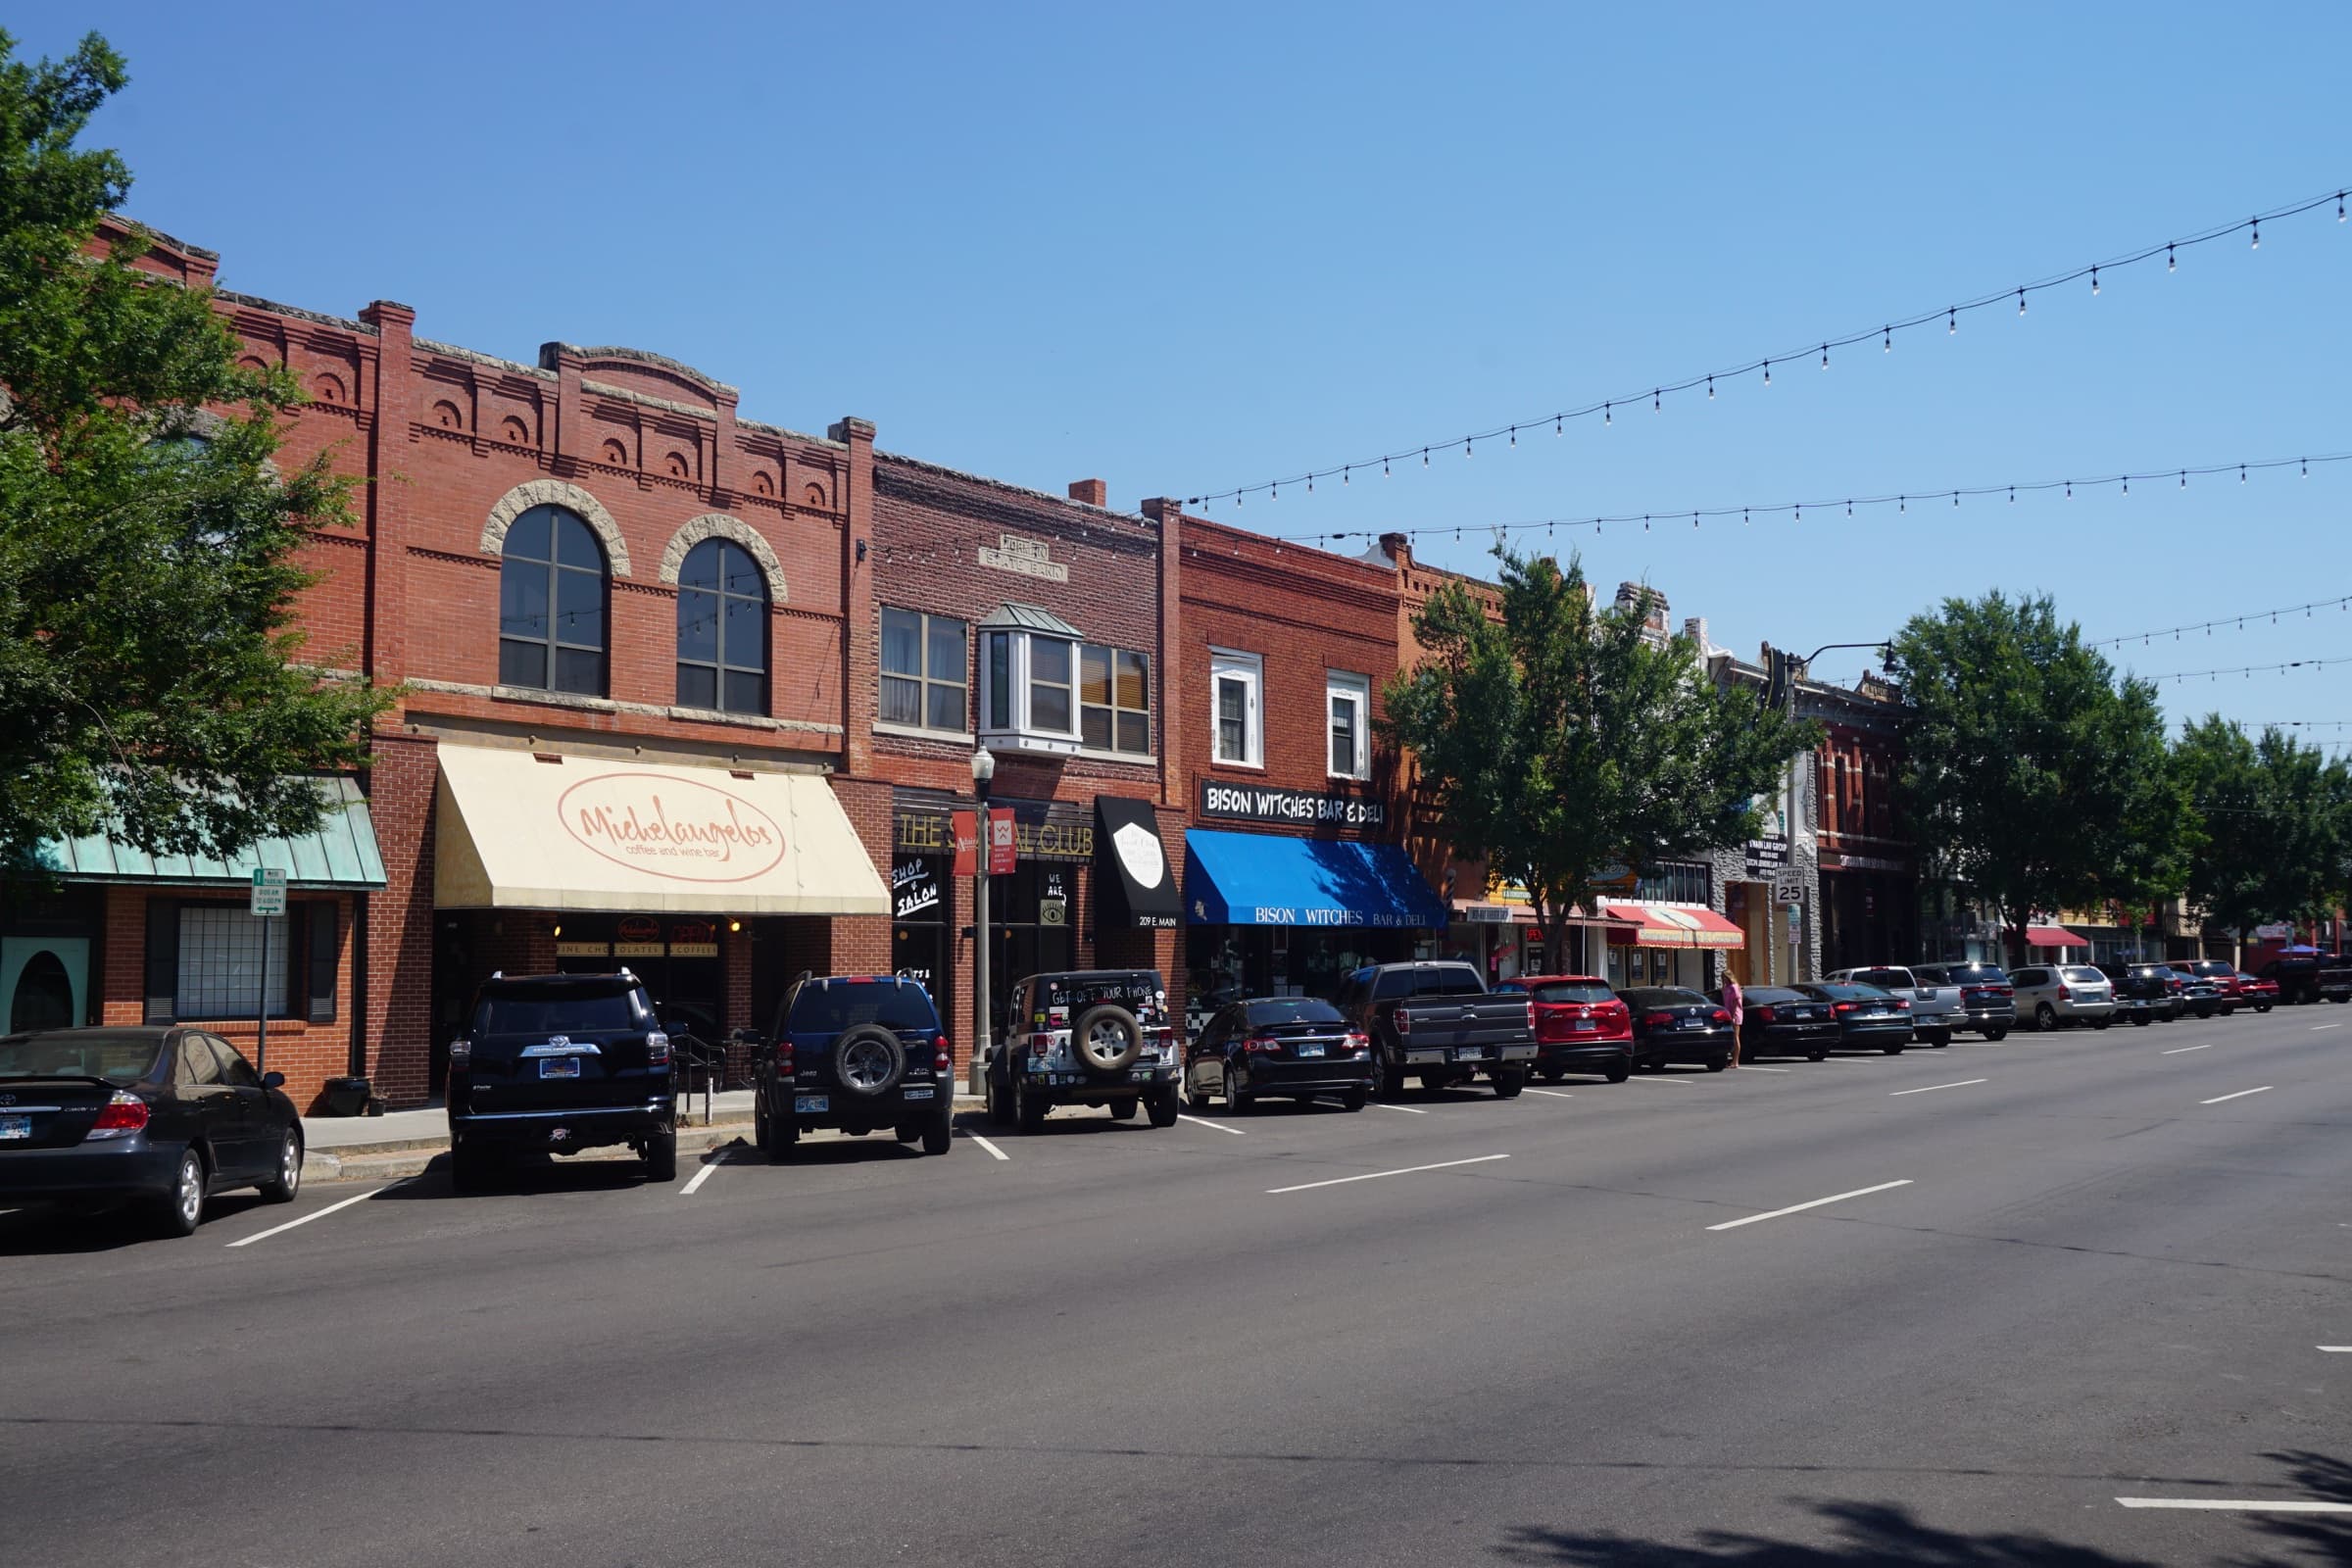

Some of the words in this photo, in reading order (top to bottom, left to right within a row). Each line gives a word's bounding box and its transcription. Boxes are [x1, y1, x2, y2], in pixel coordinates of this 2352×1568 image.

[987, 550, 1023, 570] STATE
[1031, 563, 1064, 577] BANK
[1207, 788, 1251, 813] BISON
[1255, 792, 1315, 818] WITCHES
[1317, 799, 1344, 821] BAR
[1347, 802, 1356, 822] &
[1358, 803, 1384, 824] DELI
[580, 795, 772, 861] Michelangelos
[900, 814, 942, 846] THE
[1039, 824, 1095, 856] CLUB
[625, 845, 658, 856] coffee
[660, 847, 677, 856] and
[680, 848, 702, 857] wine
[704, 849, 720, 858] bar
[893, 858, 922, 883] SHOP
[1049, 874, 1061, 883] WE
[898, 883, 937, 912] SALON
[1048, 886, 1063, 896] ARE
[1779, 886, 1801, 901] 25
[1139, 916, 1152, 926] 209
[1158, 917, 1176, 927] MAIN
[1255, 906, 1296, 924] BISON
[1305, 908, 1364, 926] WITCHES
[1373, 913, 1394, 926] BAR
[1396, 916, 1402, 926] &
[1405, 914, 1426, 926] DELI
[1053, 990, 1071, 1004] GET
[1101, 986, 1123, 1000] YOUR
[1127, 986, 1153, 999] PHONE
